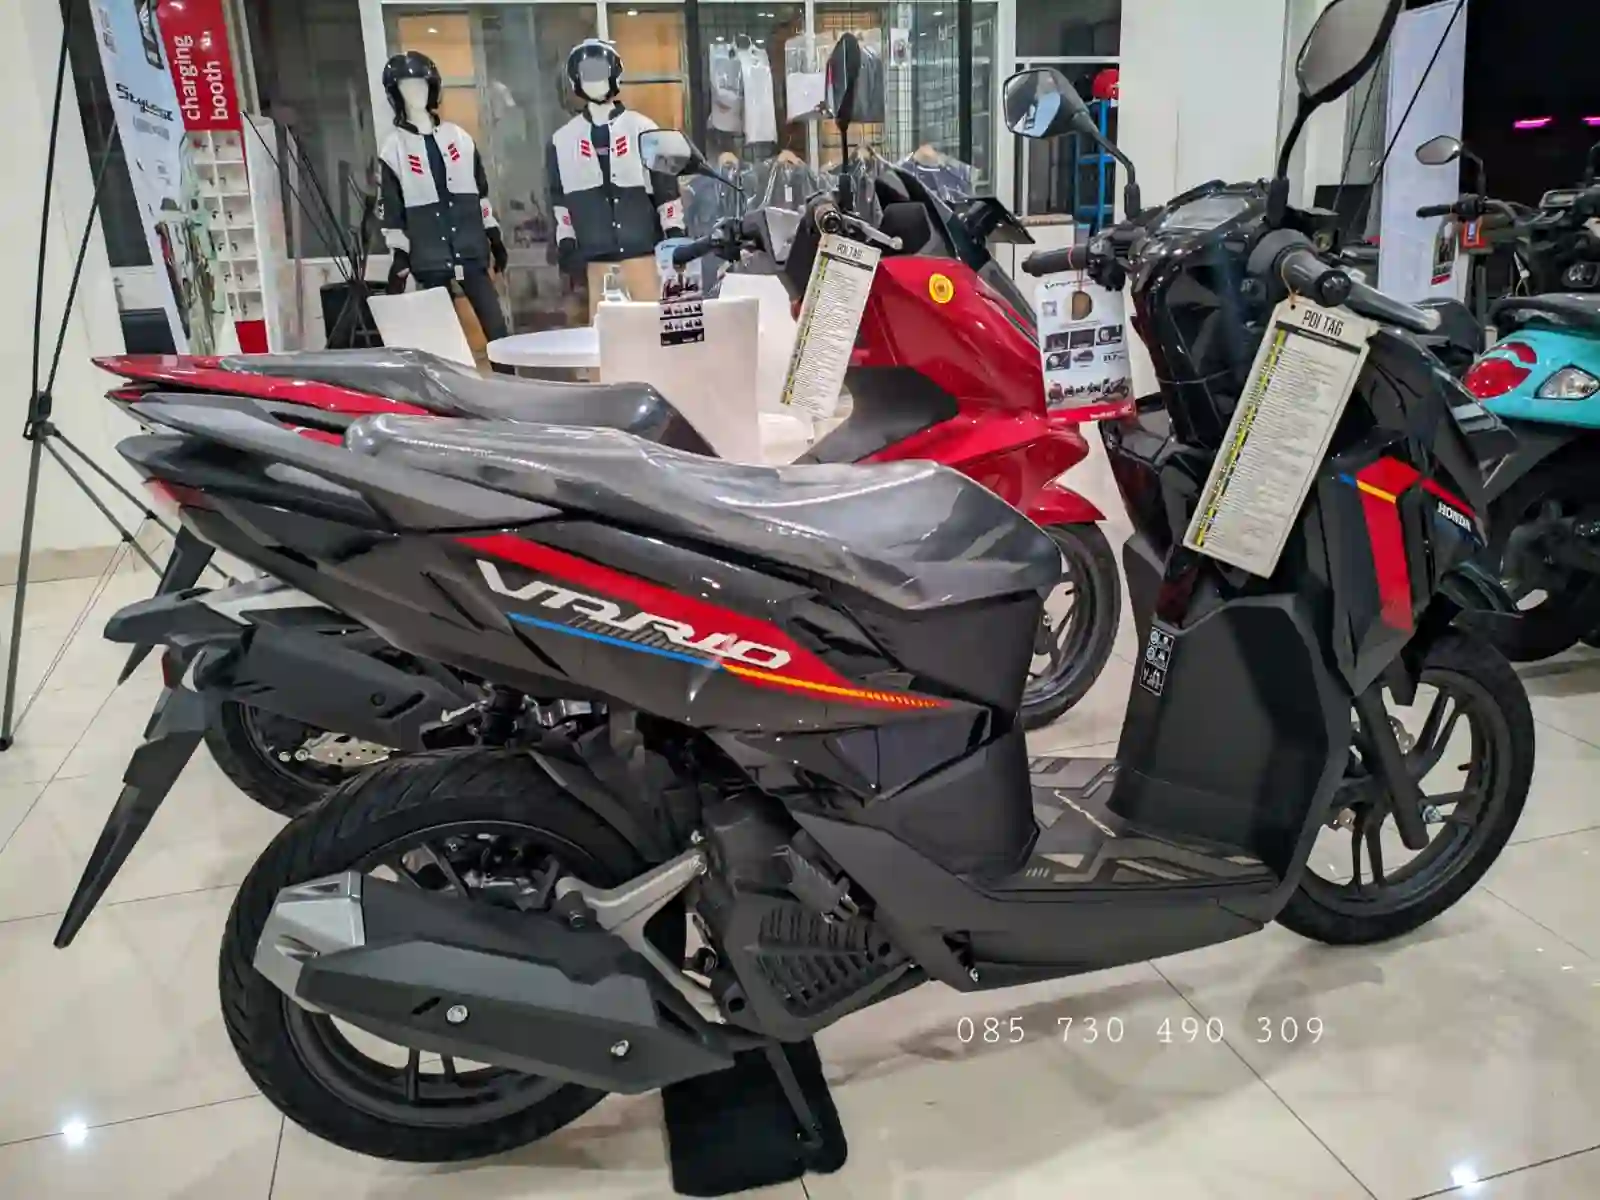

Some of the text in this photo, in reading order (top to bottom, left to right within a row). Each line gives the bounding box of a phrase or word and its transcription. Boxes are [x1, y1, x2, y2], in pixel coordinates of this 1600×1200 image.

[174, 35, 201, 120] charging
[202, 60, 229, 120] booth
[1302, 309, 1345, 337] PDI TAG
[1437, 500, 1472, 533] HONDA
